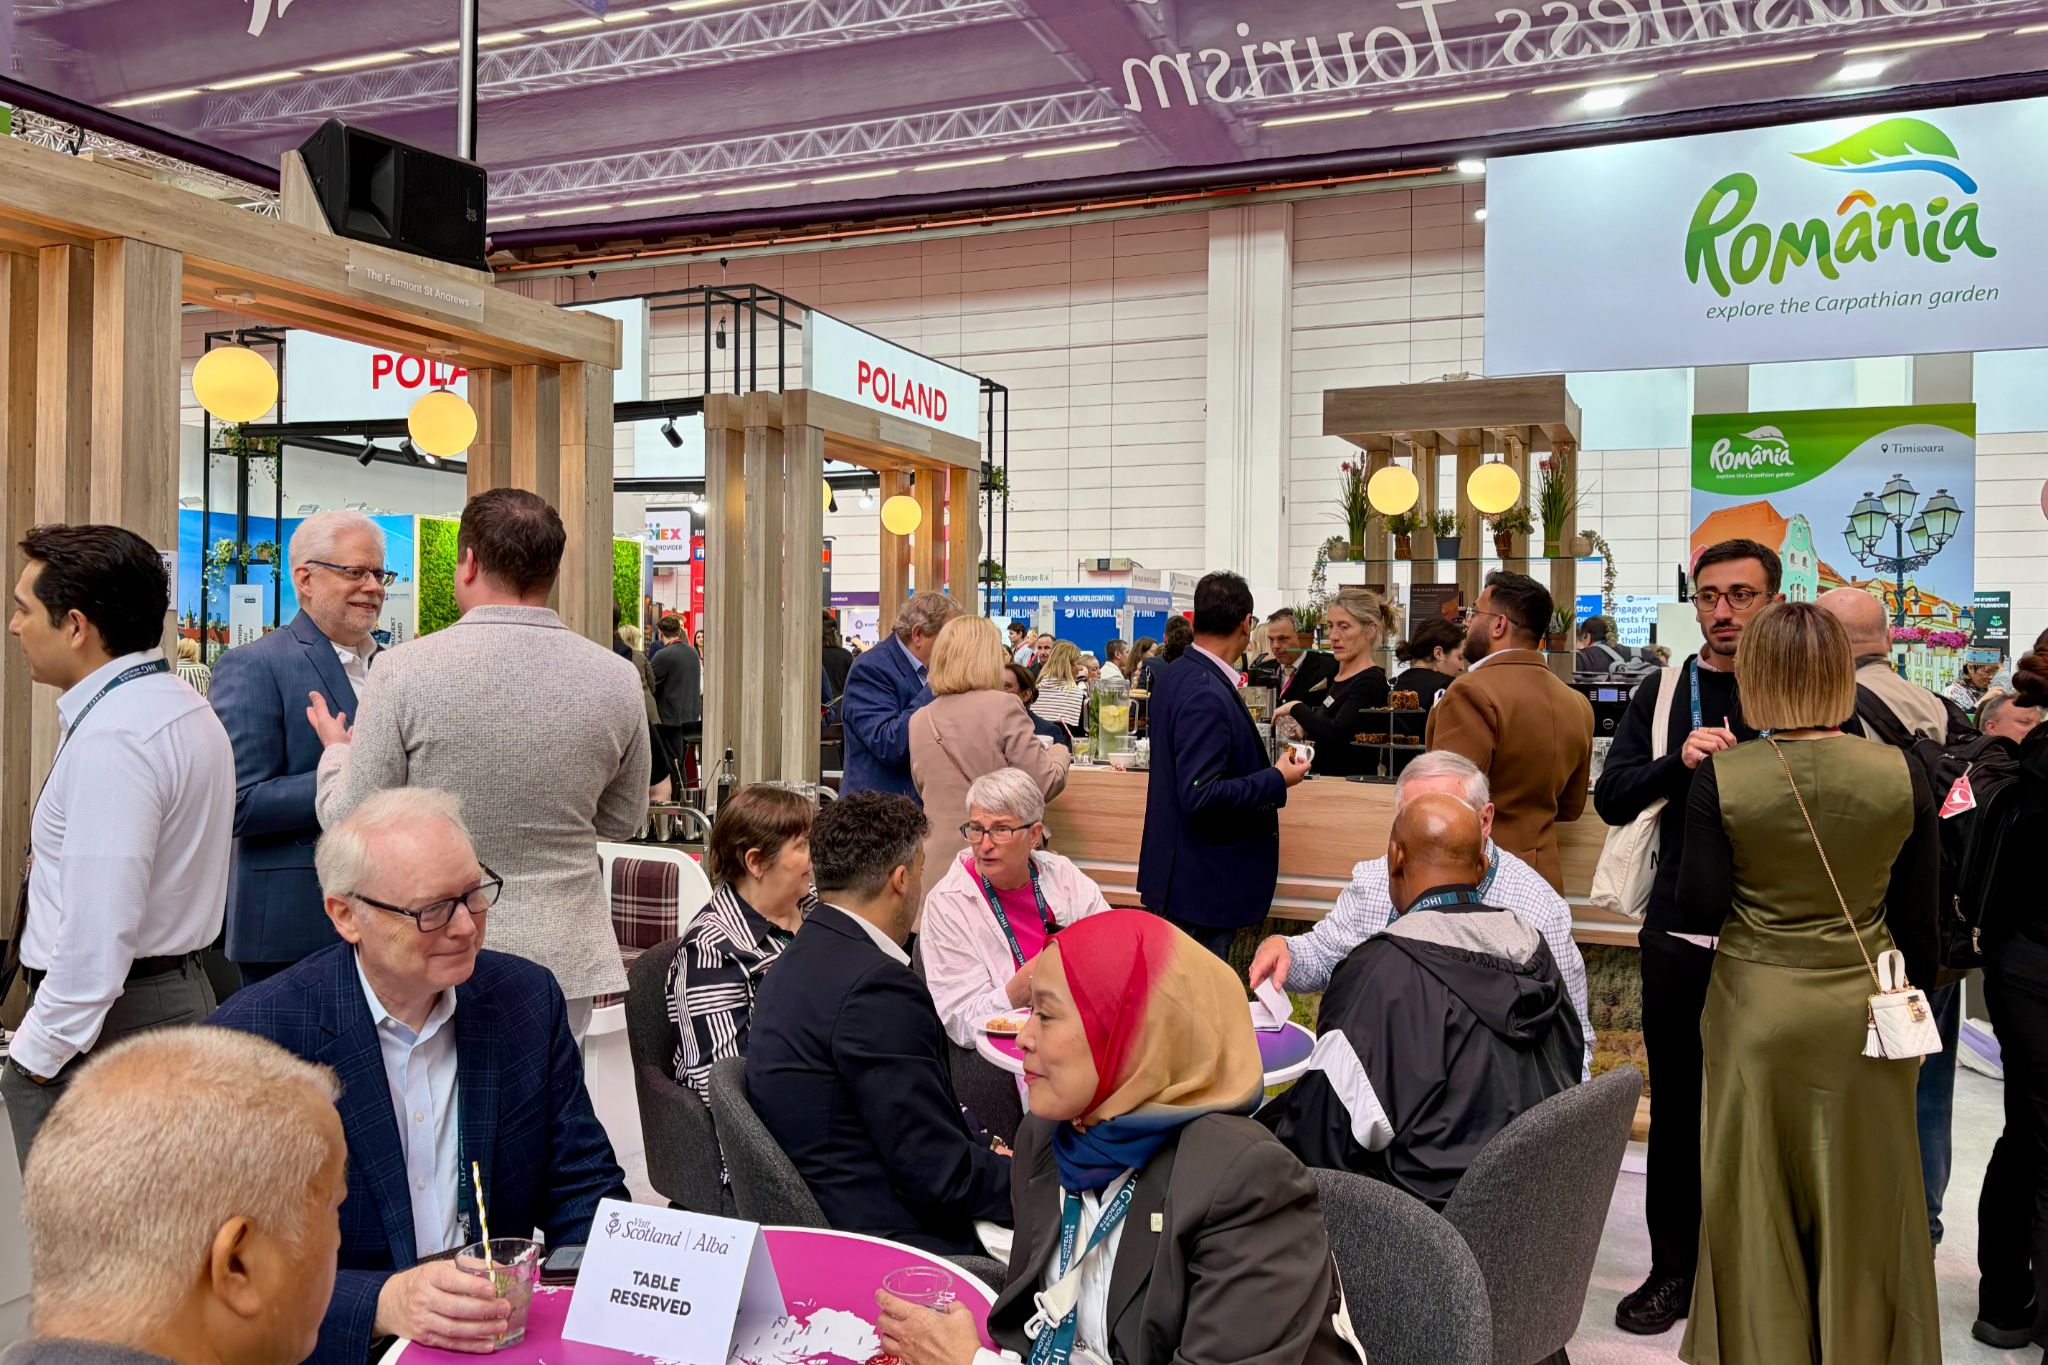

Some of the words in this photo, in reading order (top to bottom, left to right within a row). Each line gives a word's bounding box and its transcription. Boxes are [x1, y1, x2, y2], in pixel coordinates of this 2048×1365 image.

[1684, 171, 1998, 298] România
[366, 267, 383, 282] The
[384, 273, 422, 293] Fairmont
[424, 284, 434, 297] St
[434, 289, 470, 307] Andrews
[1706, 299, 1775, 322] explore
[1779, 297, 1810, 314] the
[1815, 290, 1922, 315] Carpathian
[1927, 285, 1999, 309] garden
[857, 360, 948, 422] POLAND
[1709, 437, 1794, 473] România
[1621, 636, 1643, 644] their
[1627, 626, 1648, 635] palm
[141, 663, 158, 675] IHG
[1693, 711, 1701, 728] IHG
[1422, 897, 1442, 907] IHG
[998, 913, 1009, 929] IHG
[633, 1217, 652, 1229] Visit
[1099, 1199, 1121, 1229] RESORTS
[1106, 1204, 1125, 1229] HOTELS
[621, 1220, 683, 1248] Scotland
[692, 1232, 730, 1255] Alba
[632, 1270, 681, 1293] TABLE
[609, 1288, 692, 1317] RESERVED
[1036, 1325, 1051, 1353] HOTELS
